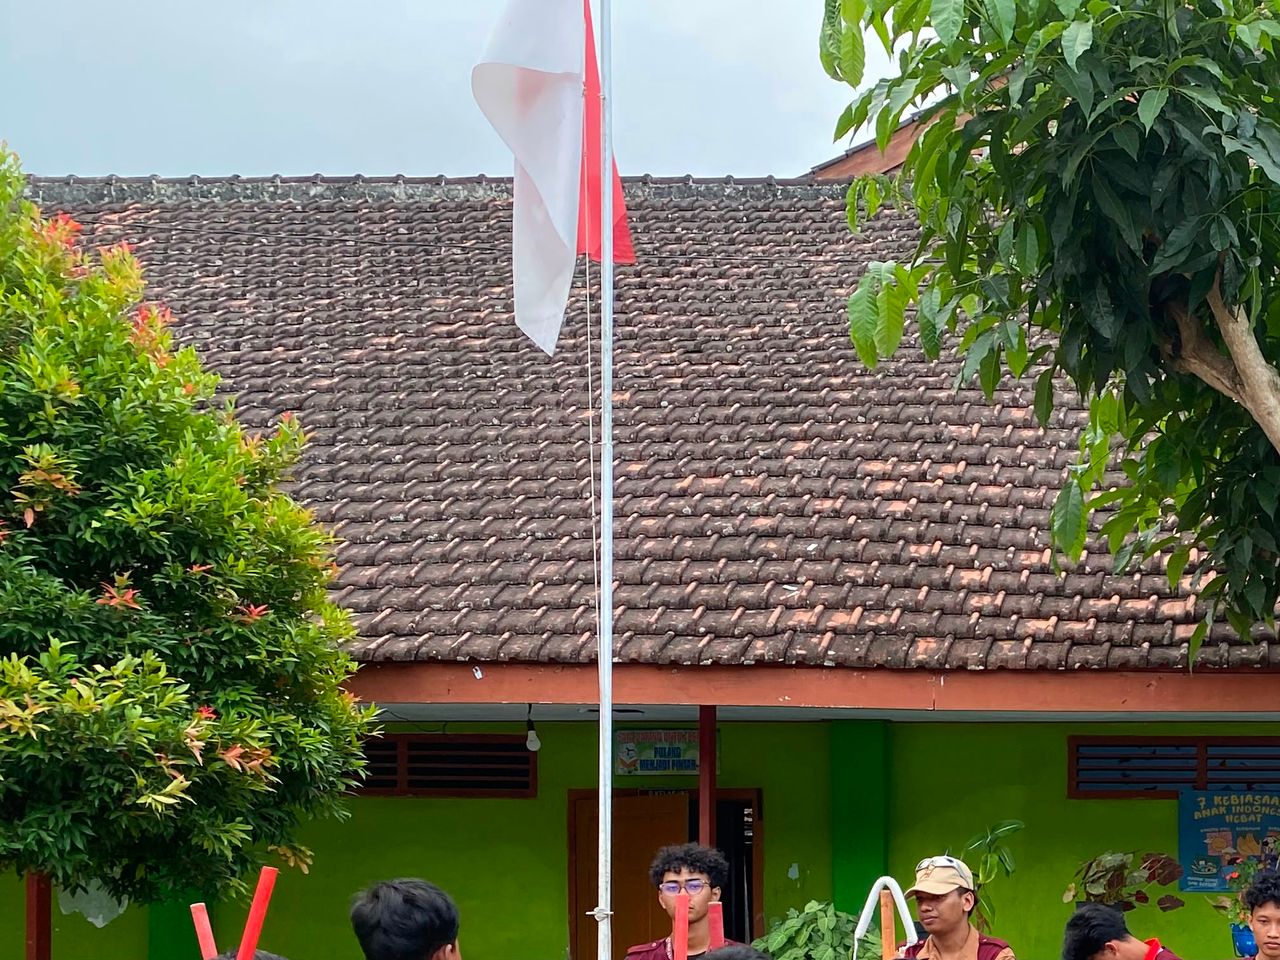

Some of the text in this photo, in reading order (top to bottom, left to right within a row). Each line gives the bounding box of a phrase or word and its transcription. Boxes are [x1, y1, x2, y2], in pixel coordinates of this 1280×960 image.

[1197, 797, 1206, 810] 7
[1194, 806, 1227, 820] ANAK
[1225, 814, 1263, 823] HEBAT
